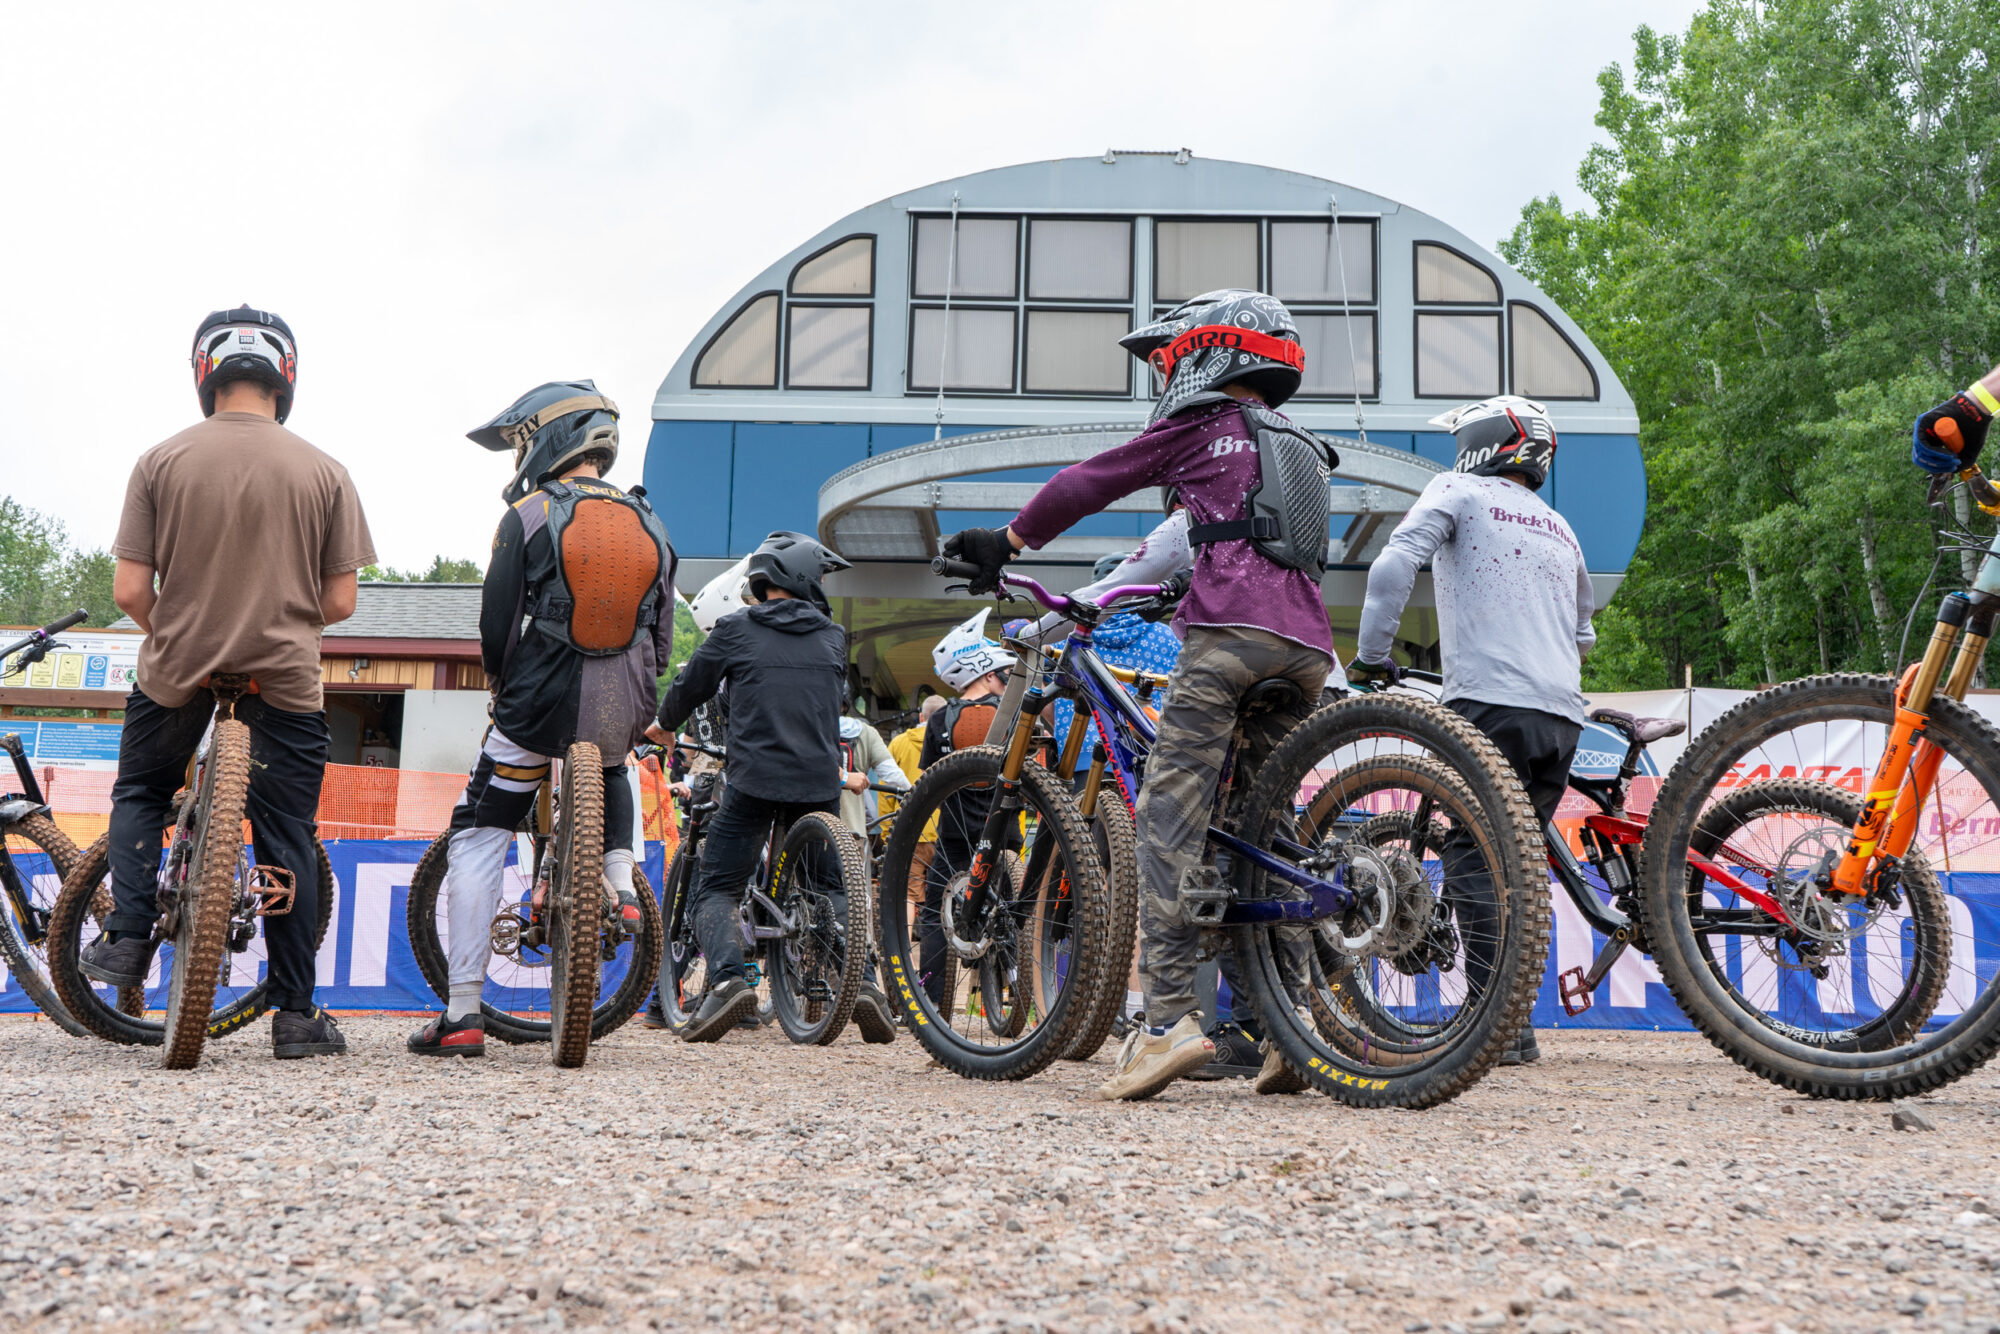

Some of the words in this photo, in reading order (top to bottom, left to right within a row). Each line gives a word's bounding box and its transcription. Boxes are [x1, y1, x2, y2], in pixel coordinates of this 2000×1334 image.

[1172, 332, 1242, 360] GIRO
[1207, 356, 1229, 377] BELL
[518, 414, 541, 443] FLY
[1489, 506, 1543, 529] Brick
[952, 643, 981, 658] THOR
[1092, 709, 1118, 764] ROCKY
[1713, 763, 1863, 793] SANTA
[771, 850, 787, 899] MAXXIS
[890, 954, 929, 1026] MAXXIS
[207, 1006, 255, 1035] MAXX
[1309, 990, 1357, 1048] MAXXIS
[1307, 1056, 1390, 1091] MAXXIS
